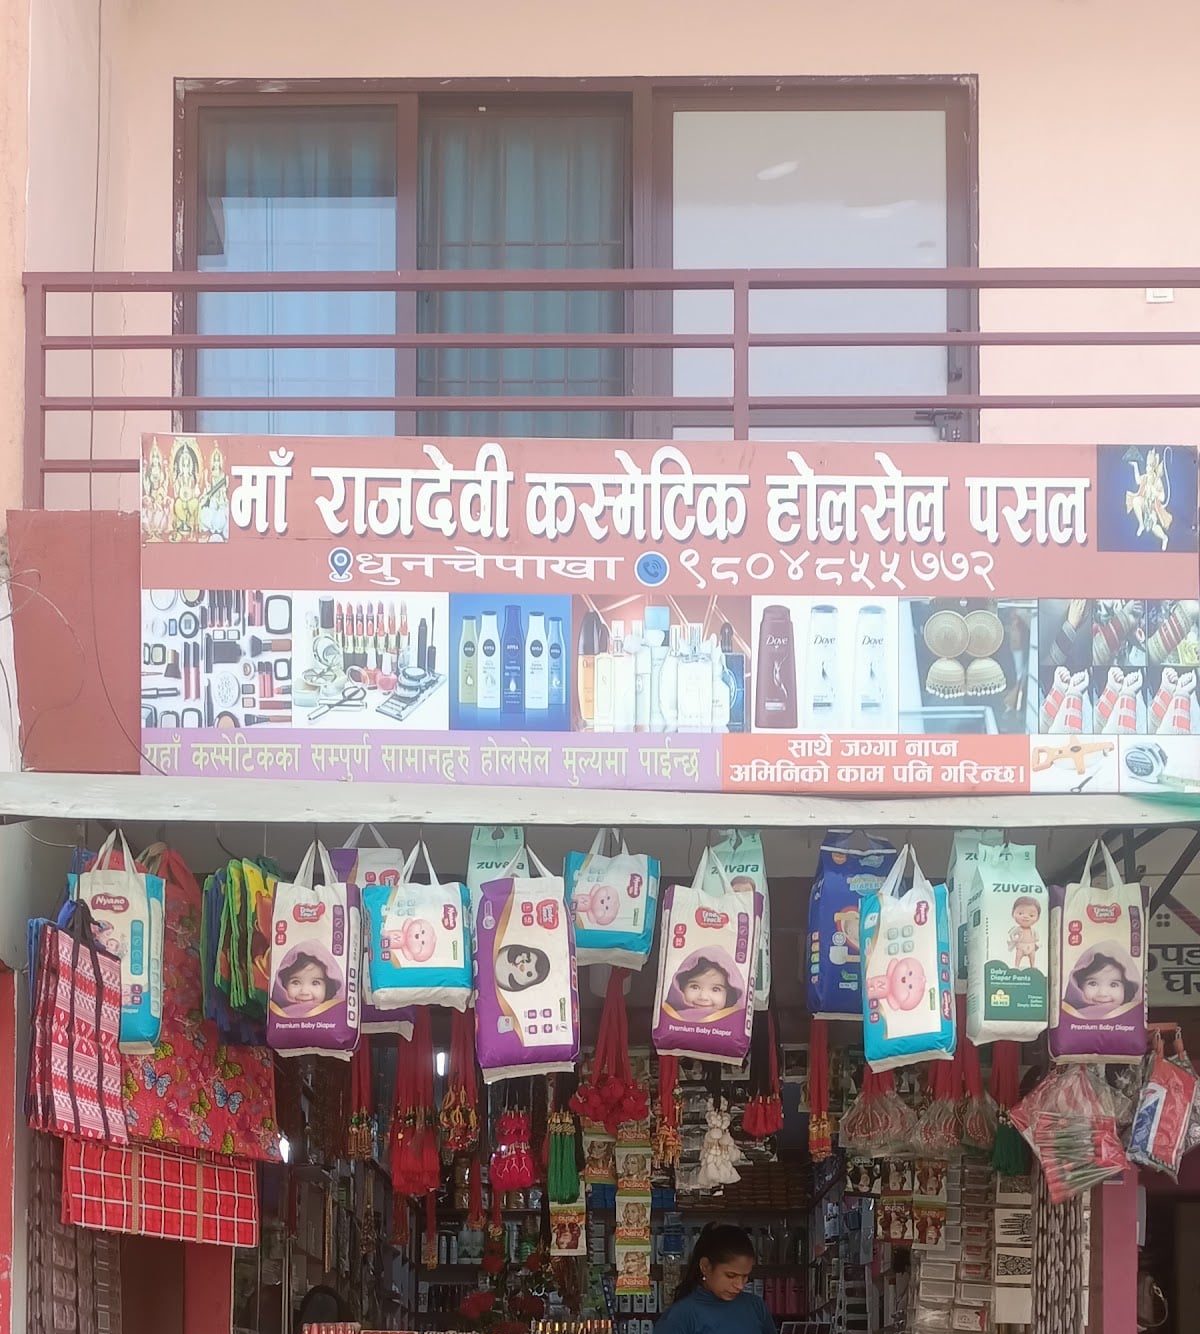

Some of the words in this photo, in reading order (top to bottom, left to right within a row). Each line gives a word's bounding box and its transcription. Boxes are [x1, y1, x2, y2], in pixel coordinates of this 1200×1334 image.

[231, 446, 294, 535] माँ
[311, 442, 514, 540] राजदेवी
[525, 446, 749, 541] कस्मेटिक
[766, 451, 948, 543] होलसेल
[965, 476, 1091, 545] पसल
[356, 546, 624, 585] धुनचेपाखा
[679, 548, 995, 591] ९८०४८५५७७२
[765, 634, 788, 645] Dove
[813, 634, 836, 645] Dove
[861, 635, 884, 645] Dove
[788, 733, 833, 757] साथै
[840, 739, 898, 757] जग्गा
[905, 739, 959, 757] नाप्न
[144, 733, 181, 773] यहाँ
[191, 732, 301, 773] कस्मेटिकका
[480, 736, 552, 776] होलसेल
[562, 747, 628, 786] मुल्यमा
[639, 736, 700, 783] पाईन्छ
[729, 759, 830, 783] अमिनिको
[837, 765, 886, 783] काम
[893, 760, 934, 783] पनि
[992, 883, 1043, 893] zuvara
[95, 896, 126, 906] Nyano
[300, 1022, 315, 1030] Baby
[316, 1022, 336, 1030] Diaper
[669, 1024, 695, 1033] Premium
[696, 1026, 711, 1036] Baby
[711, 1029, 732, 1037] Diaper
[1099, 1023, 1114, 1032] Baby
[1115, 1024, 1135, 1032] Diaper
